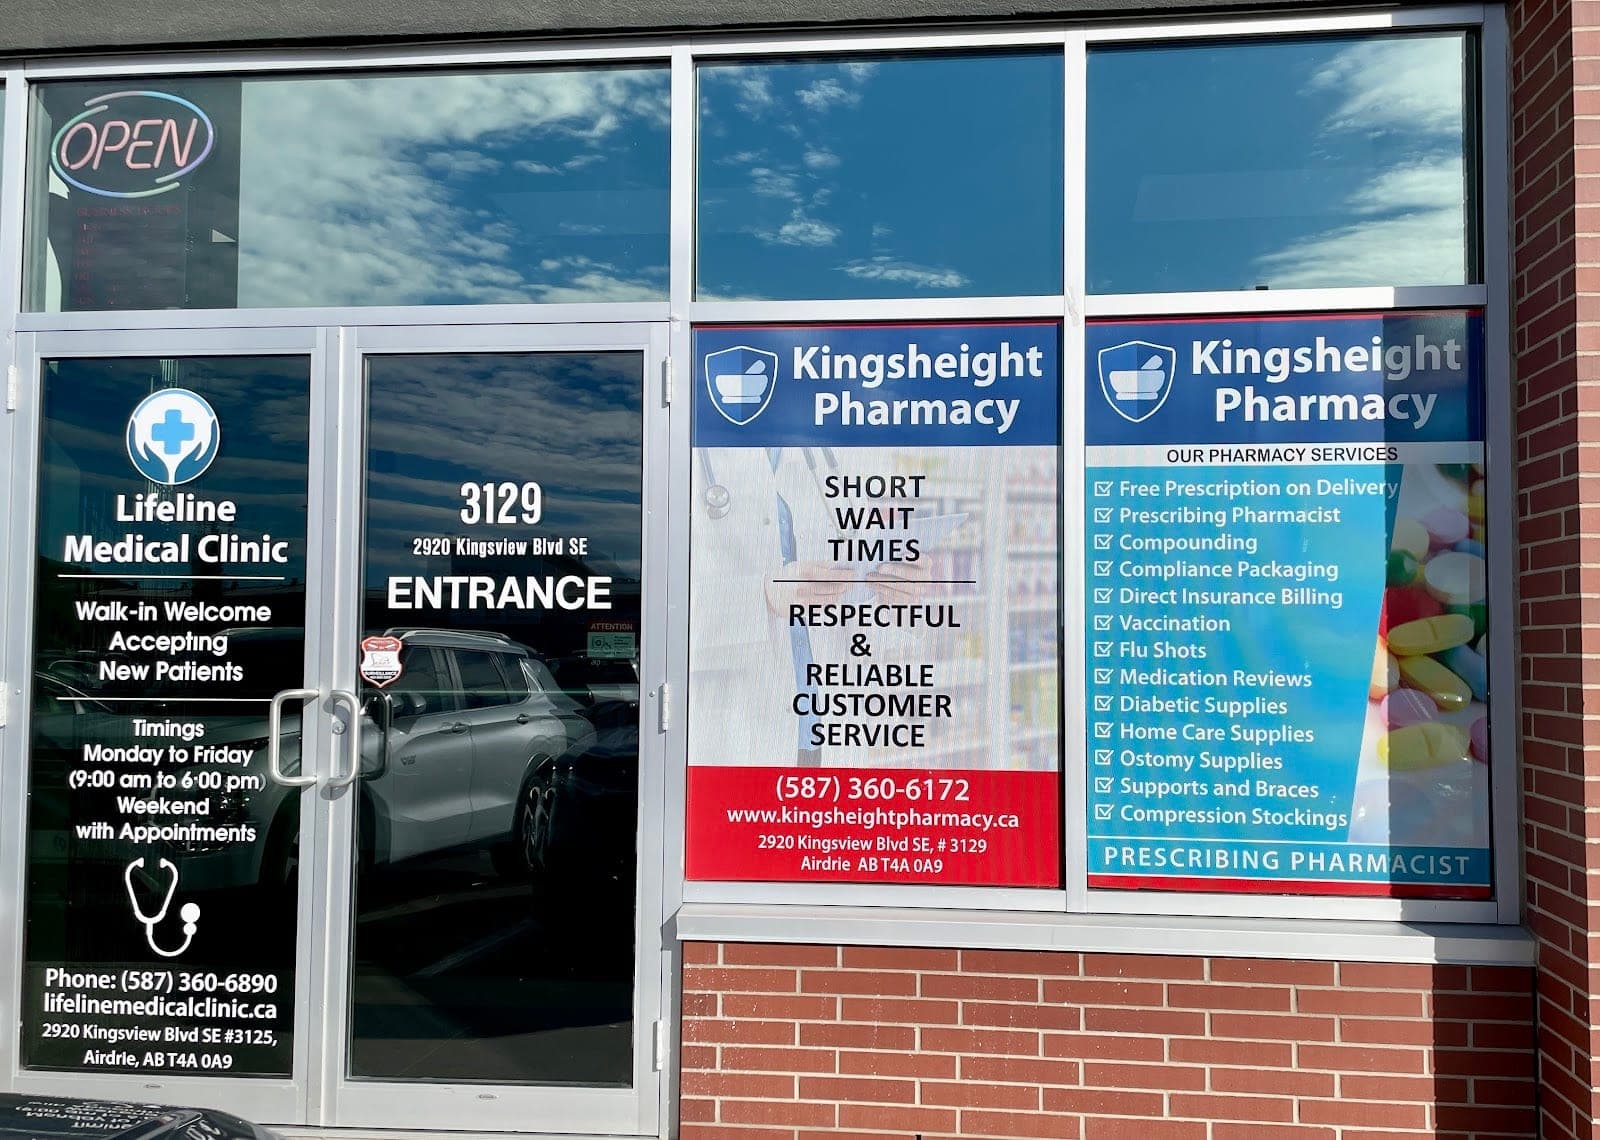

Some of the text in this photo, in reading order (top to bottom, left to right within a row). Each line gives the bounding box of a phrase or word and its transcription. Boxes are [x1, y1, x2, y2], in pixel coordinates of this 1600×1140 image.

[61, 118, 198, 170] OPEN
[792, 342, 1043, 388] Kingsheight
[1191, 334, 1463, 384] Kingsheight
[814, 391, 1021, 434] Pharmacy
[1215, 386, 1438, 430] Pharmacy
[1166, 447, 1398, 463] OUR PHARMACY SERVICES
[825, 475, 925, 499] SHORT
[1119, 479, 1399, 502] Free Prescription on Delivery
[116, 493, 236, 522] Lifeline
[460, 481, 543, 524] 3129
[835, 507, 915, 530] WAIT
[1119, 506, 1341, 527] Prescribing Pharmacist
[64, 535, 289, 564] Medical Clinic
[412, 537, 588, 559] 2920 Kingsview Blvd SE
[828, 538, 920, 562] TIMES
[1119, 534, 1258, 555] Compounding
[1119, 561, 1339, 582] Compliance Packaging
[388, 576, 612, 610] ENTRANCE
[1119, 588, 1343, 609] Direct Insurance Billing
[75, 601, 271, 622] Walk-in Welcome
[788, 604, 961, 628] RESPECTFUL
[590, 622, 633, 630] ATTENTION
[1119, 615, 1231, 633] Vaccination
[108, 631, 228, 656] Accepting
[850, 633, 872, 657] &
[1119, 642, 1207, 659] Flu Shots
[99, 661, 244, 682] New Patients
[806, 663, 934, 687] RELIABLE
[1119, 669, 1313, 688] Medication Reviews
[792, 693, 952, 718] CUSTOMER
[1119, 696, 1289, 719] Diabetic Supplies
[132, 720, 205, 741] Timings
[810, 723, 925, 747] SERVICE
[1119, 723, 1315, 747] Home Care Supplies
[83, 745, 254, 768] Monday to Friday
[1119, 751, 1283, 774] Ostomy Supplies
[68, 771, 266, 792] (9:00 am to 6:00 pm)
[775, 775, 970, 803] (587) 360-6172
[1119, 778, 1320, 800] Supports and Braces
[117, 797, 210, 815] Weekend
[727, 807, 1020, 831] www.kingsheightpharmacy.ca
[1119, 805, 1348, 831] Compression Stockings
[76, 823, 257, 844] with Appointments
[758, 835, 988, 855] 2920 Kingsview Blvd SE, # 3129
[800, 856, 943, 873] Airdrie AB T4A 0A9
[1105, 847, 1471, 876] PRESCRIBING PHARMACIST
[45, 968, 278, 994] Phone: (587) 360-6890
[43, 993, 277, 1019] lifelinemedicalclinic.ca
[42, 1024, 279, 1047] 2920 Kingsview Blvd SE #3125,
[84, 1049, 233, 1069] Airdrie, AB T4A 0A9
